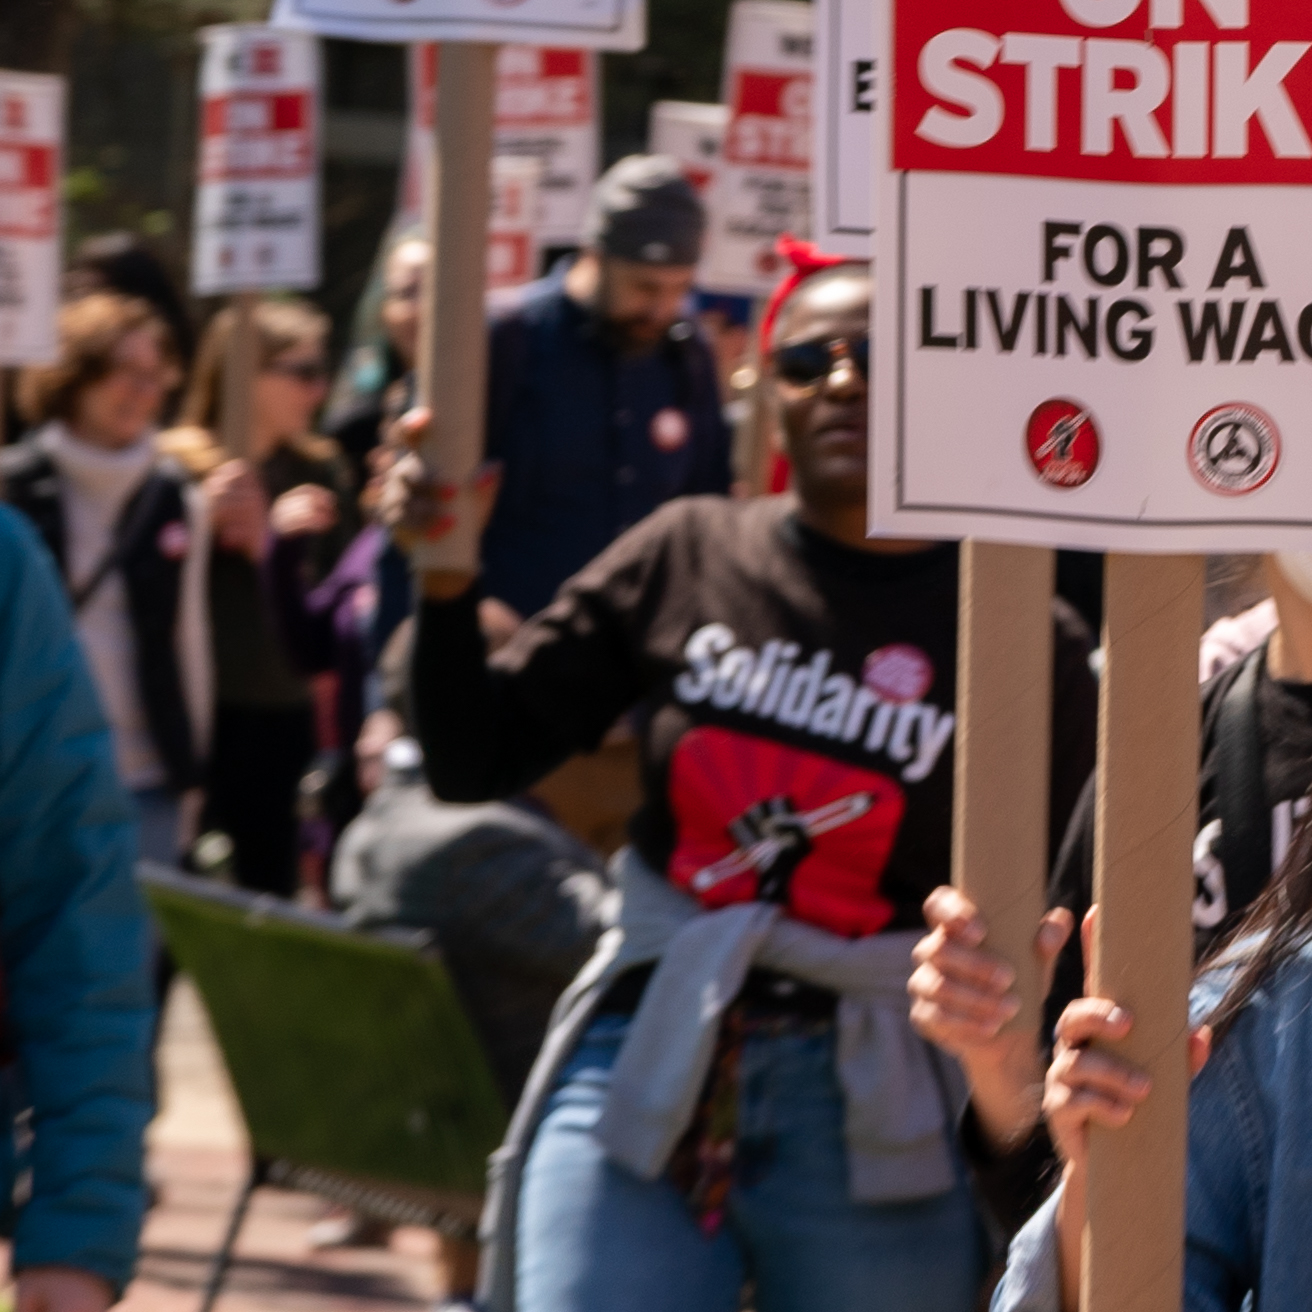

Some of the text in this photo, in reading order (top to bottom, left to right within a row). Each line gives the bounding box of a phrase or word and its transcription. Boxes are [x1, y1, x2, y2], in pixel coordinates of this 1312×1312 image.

[1041, 220, 1267, 289] FOR A
[918, 286, 1155, 362] LIVING
